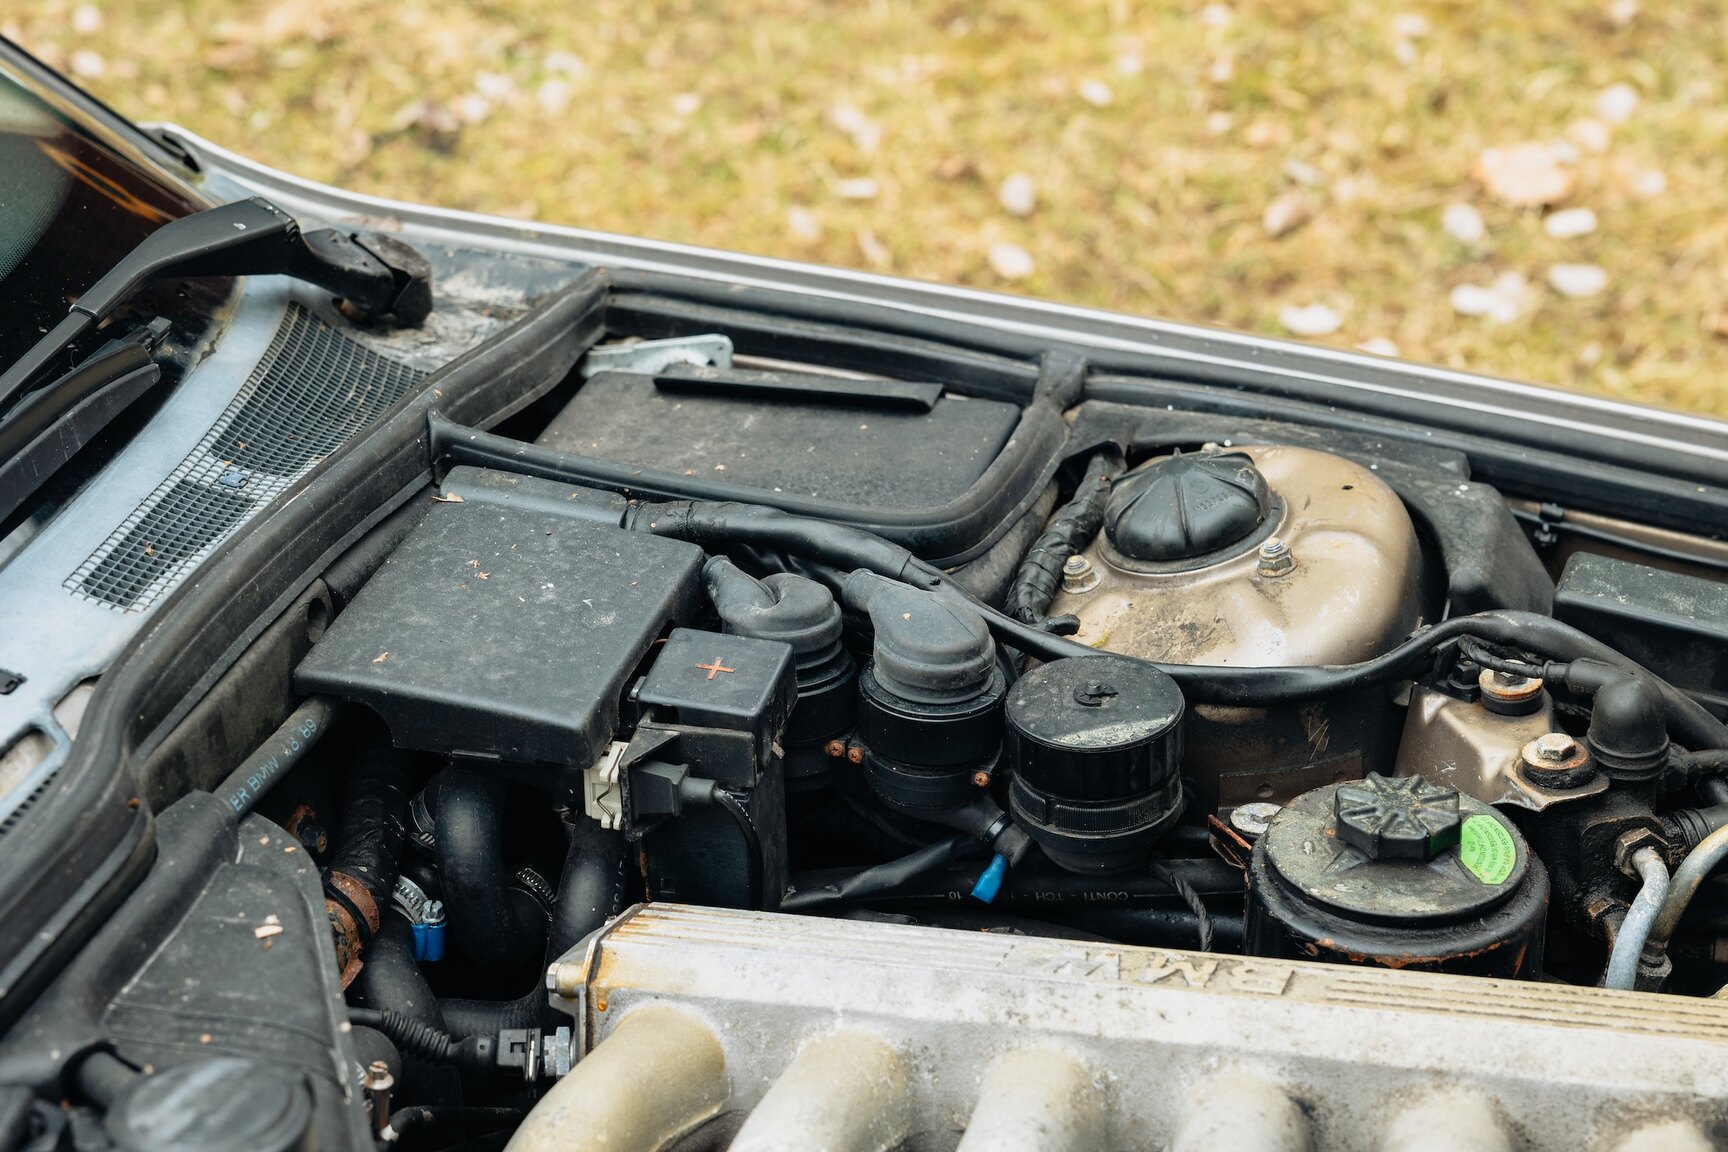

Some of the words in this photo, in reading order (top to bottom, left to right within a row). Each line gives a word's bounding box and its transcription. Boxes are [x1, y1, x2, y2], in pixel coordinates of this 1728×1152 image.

[230, 788, 250, 811] ER
[247, 756, 279, 791] BMW
[300, 719, 317, 738] 89
[1035, 892, 1064, 900] TCH
[1083, 891, 1129, 900] CONTI
